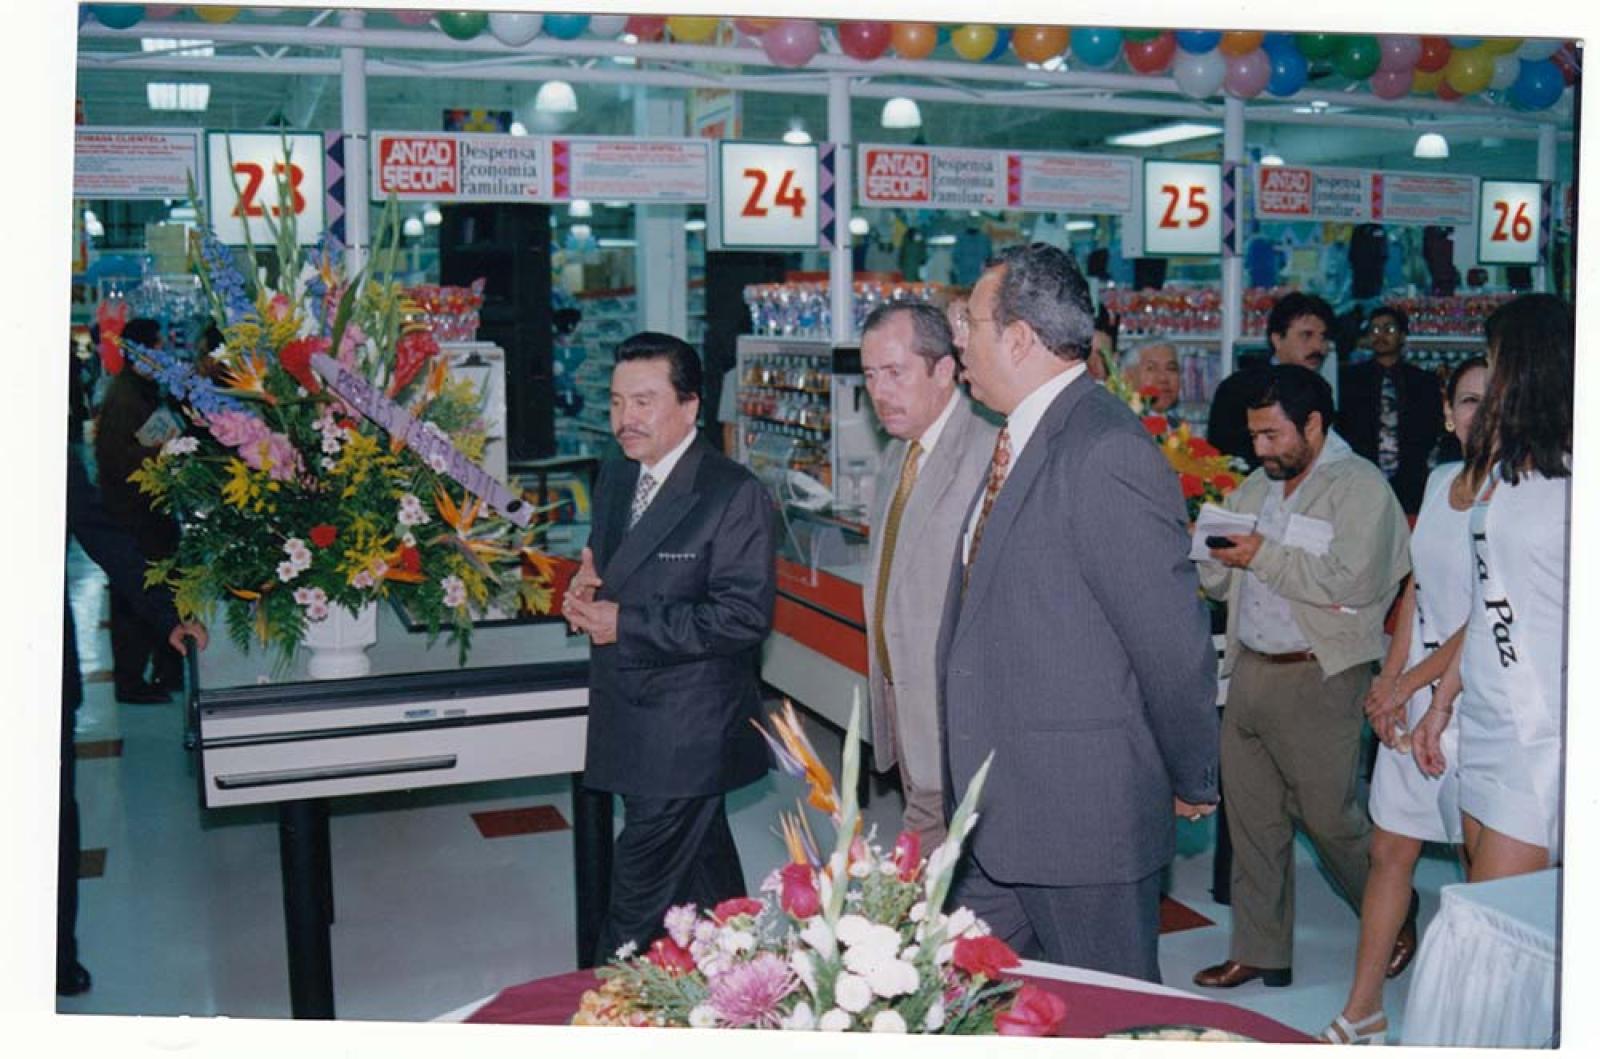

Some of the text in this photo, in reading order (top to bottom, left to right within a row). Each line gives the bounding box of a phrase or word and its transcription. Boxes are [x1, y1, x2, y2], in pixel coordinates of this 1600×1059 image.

[385, 140, 451, 165] ANTAD
[460, 140, 536, 162] Despensa
[871, 152, 926, 176] ANTAD
[231, 161, 306, 218] 23
[740, 168, 807, 219] 24
[1158, 184, 1210, 229] 25
[1490, 201, 1532, 243] 26
[1484, 597, 1518, 668] Paz
